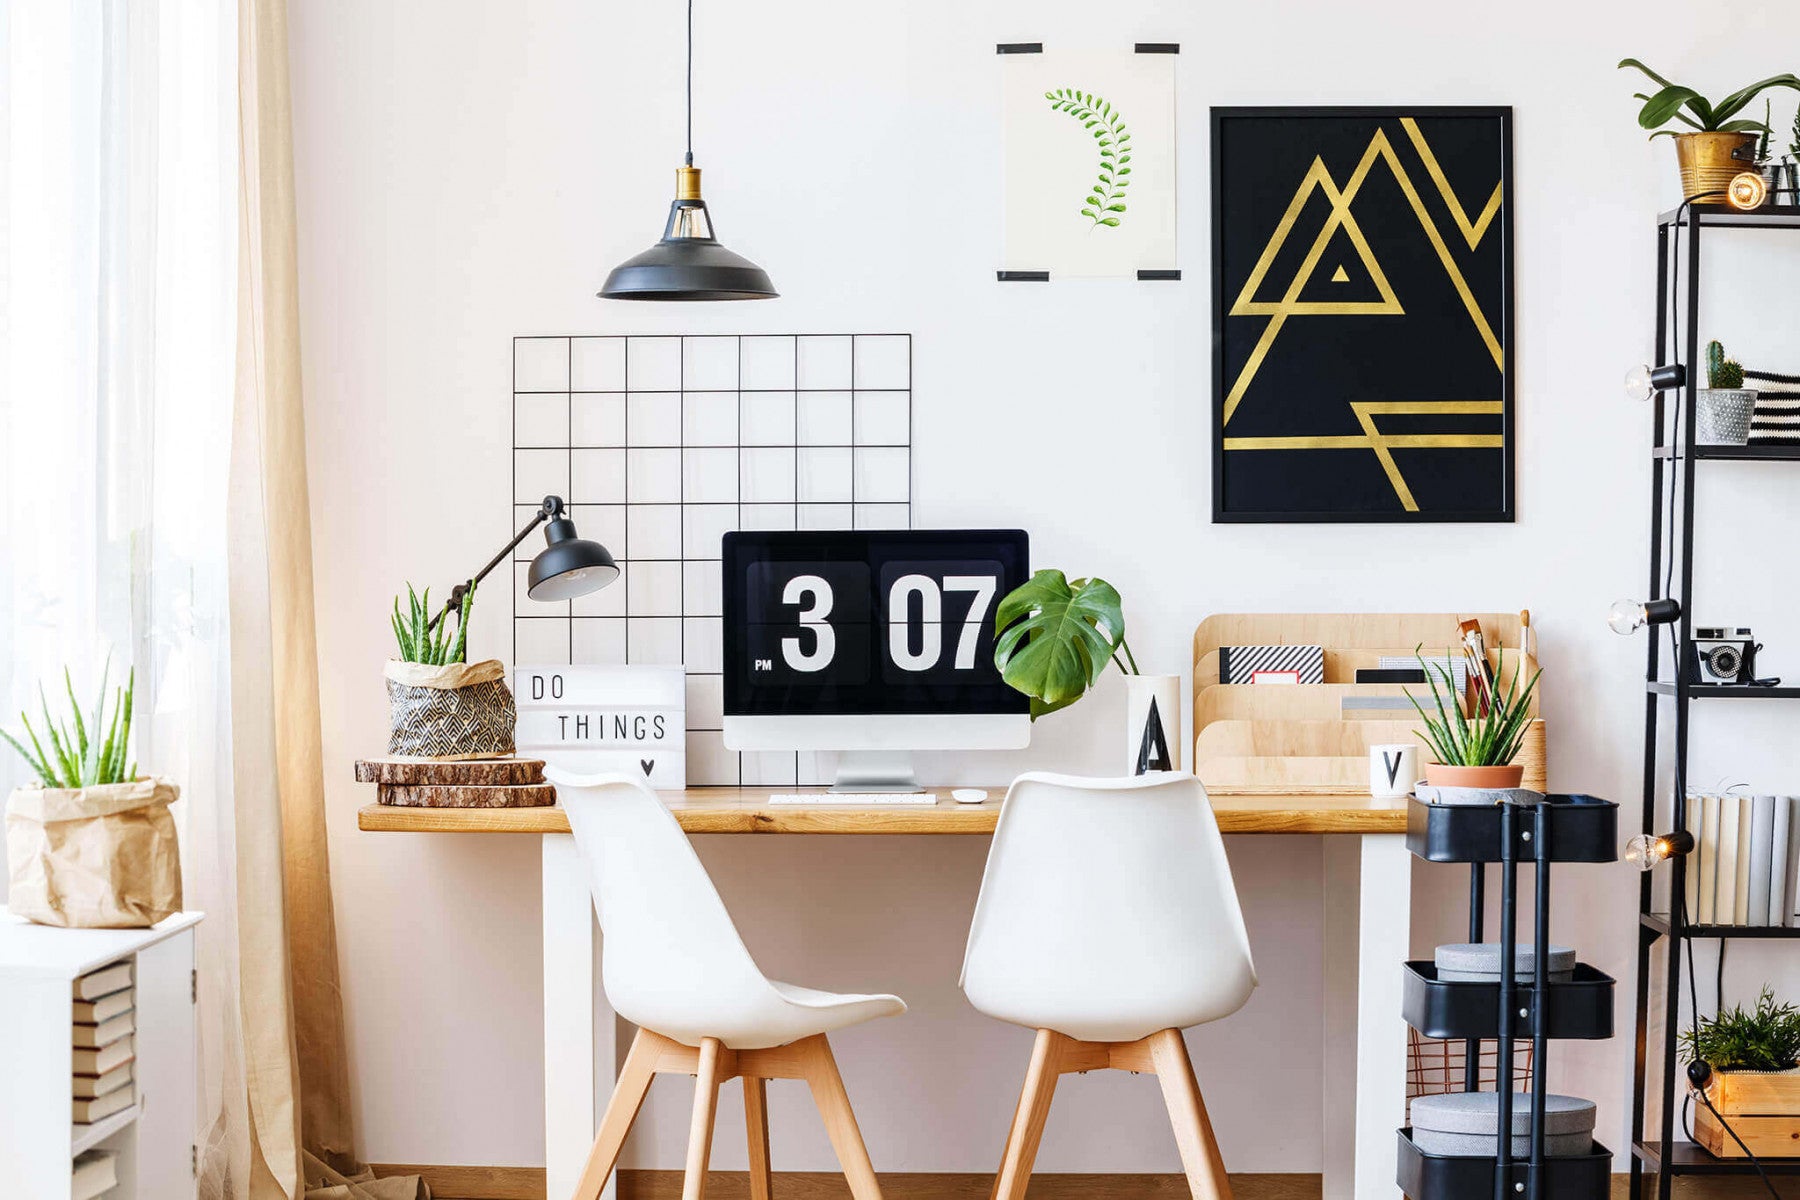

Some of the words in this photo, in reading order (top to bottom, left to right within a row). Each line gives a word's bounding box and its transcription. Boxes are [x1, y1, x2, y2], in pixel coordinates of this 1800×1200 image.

[781, 574, 836, 673] 3
[889, 574, 997, 672] 07
[755, 659, 772, 671] PM
[532, 674, 564, 699] DO
[558, 714, 665, 740] THINGS
[1135, 694, 1173, 776] A
[1382, 751, 1403, 789] V
